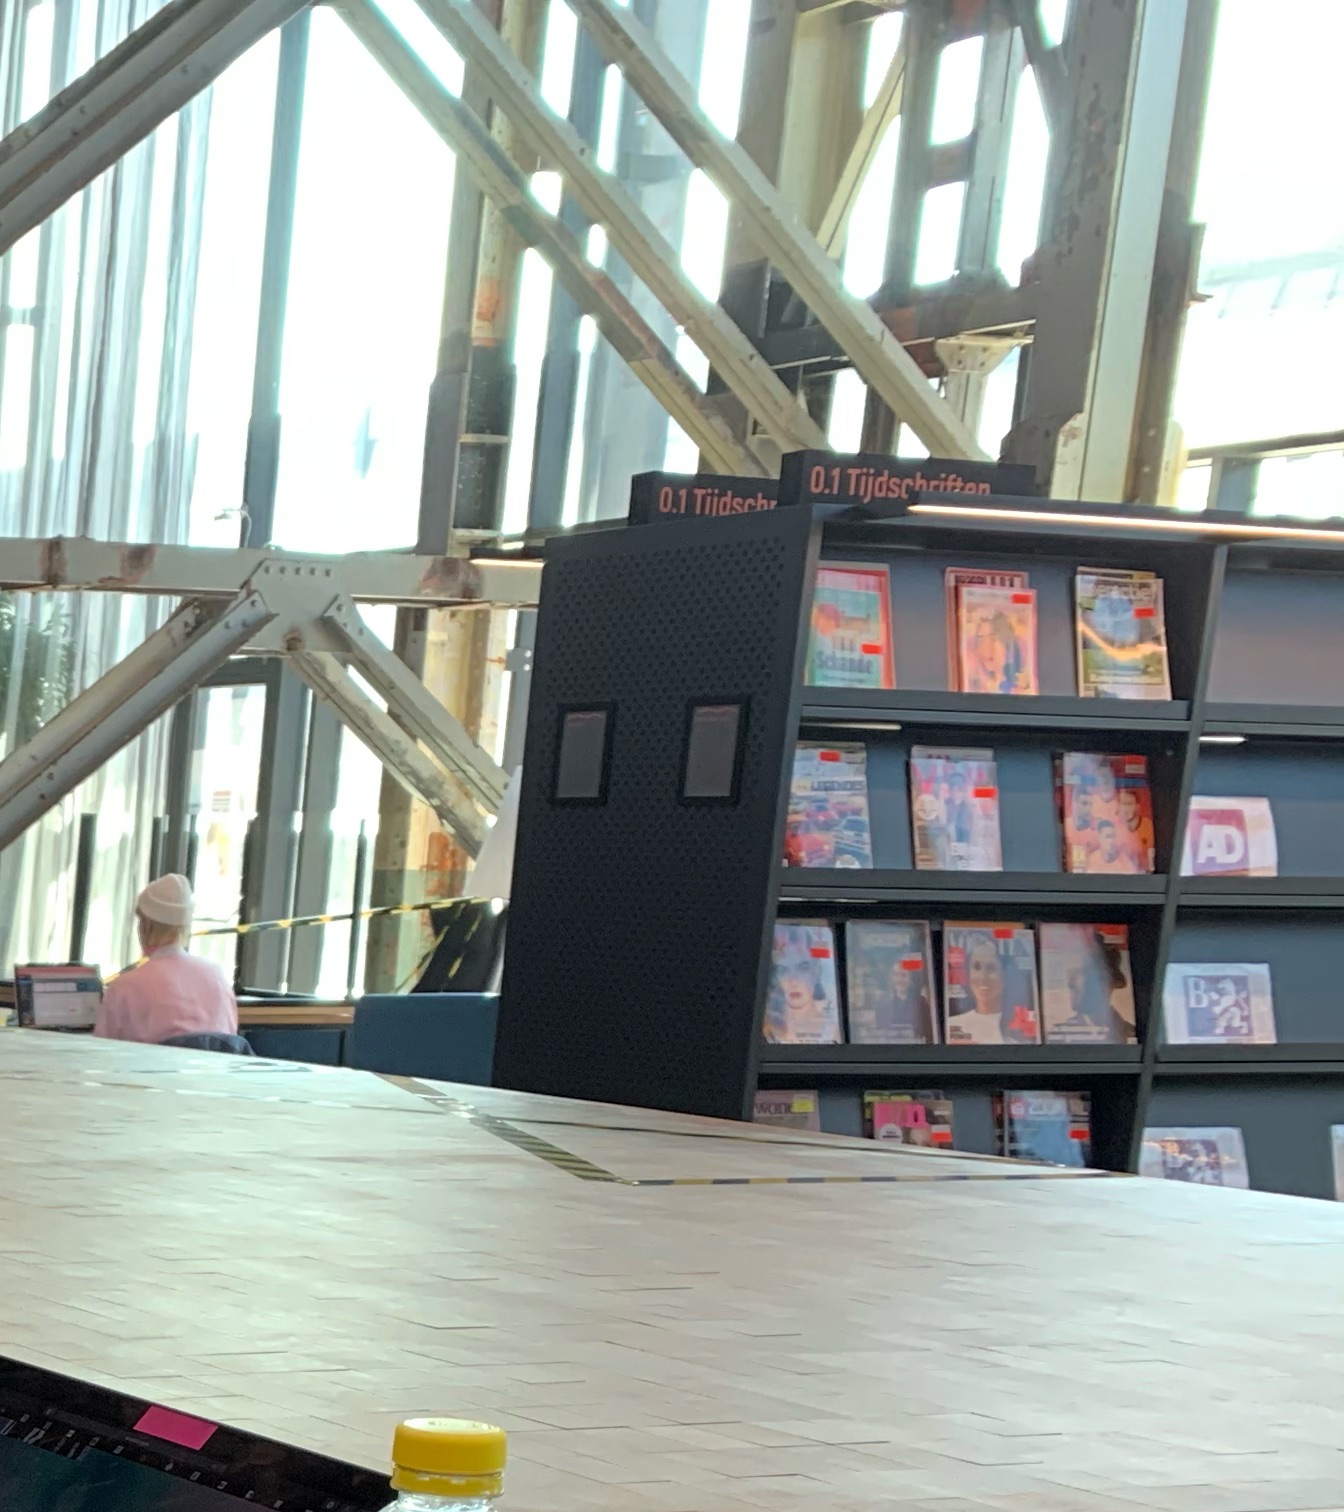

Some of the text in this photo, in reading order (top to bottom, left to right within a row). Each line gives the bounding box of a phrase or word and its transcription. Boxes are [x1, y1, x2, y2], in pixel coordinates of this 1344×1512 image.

[810, 465, 840, 494] 0.1
[659, 486, 687, 514] 0.1
[1197, 825, 1245, 865] AD
